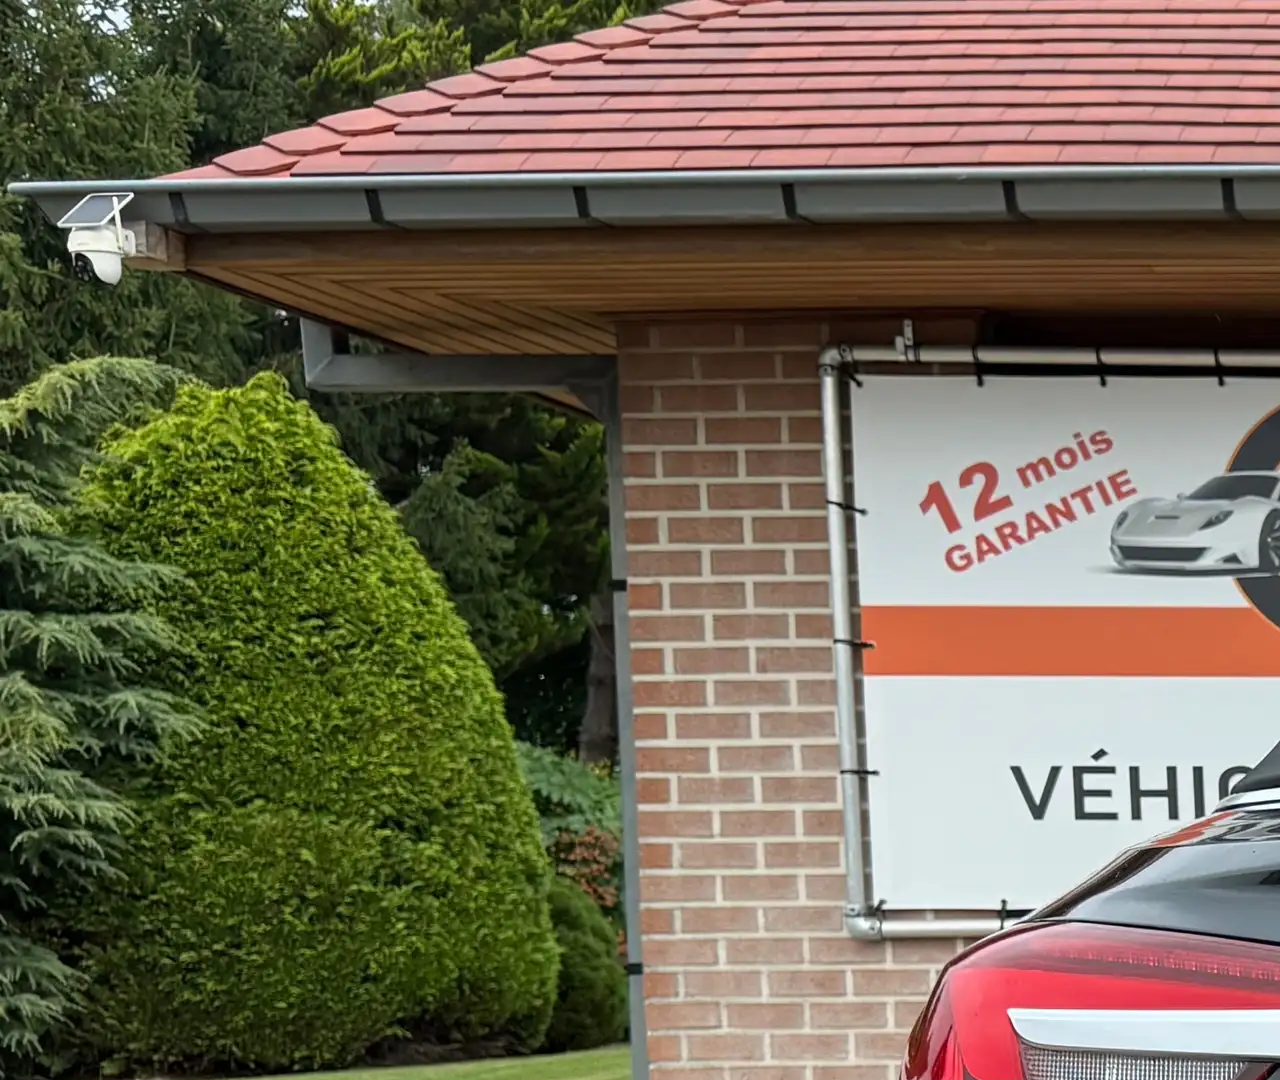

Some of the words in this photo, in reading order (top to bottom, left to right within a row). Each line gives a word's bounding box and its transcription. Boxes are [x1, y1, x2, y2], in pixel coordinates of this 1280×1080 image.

[919, 459, 1013, 534] 12
[1015, 427, 1114, 488] mois
[943, 470, 1138, 574] GARANTIE
